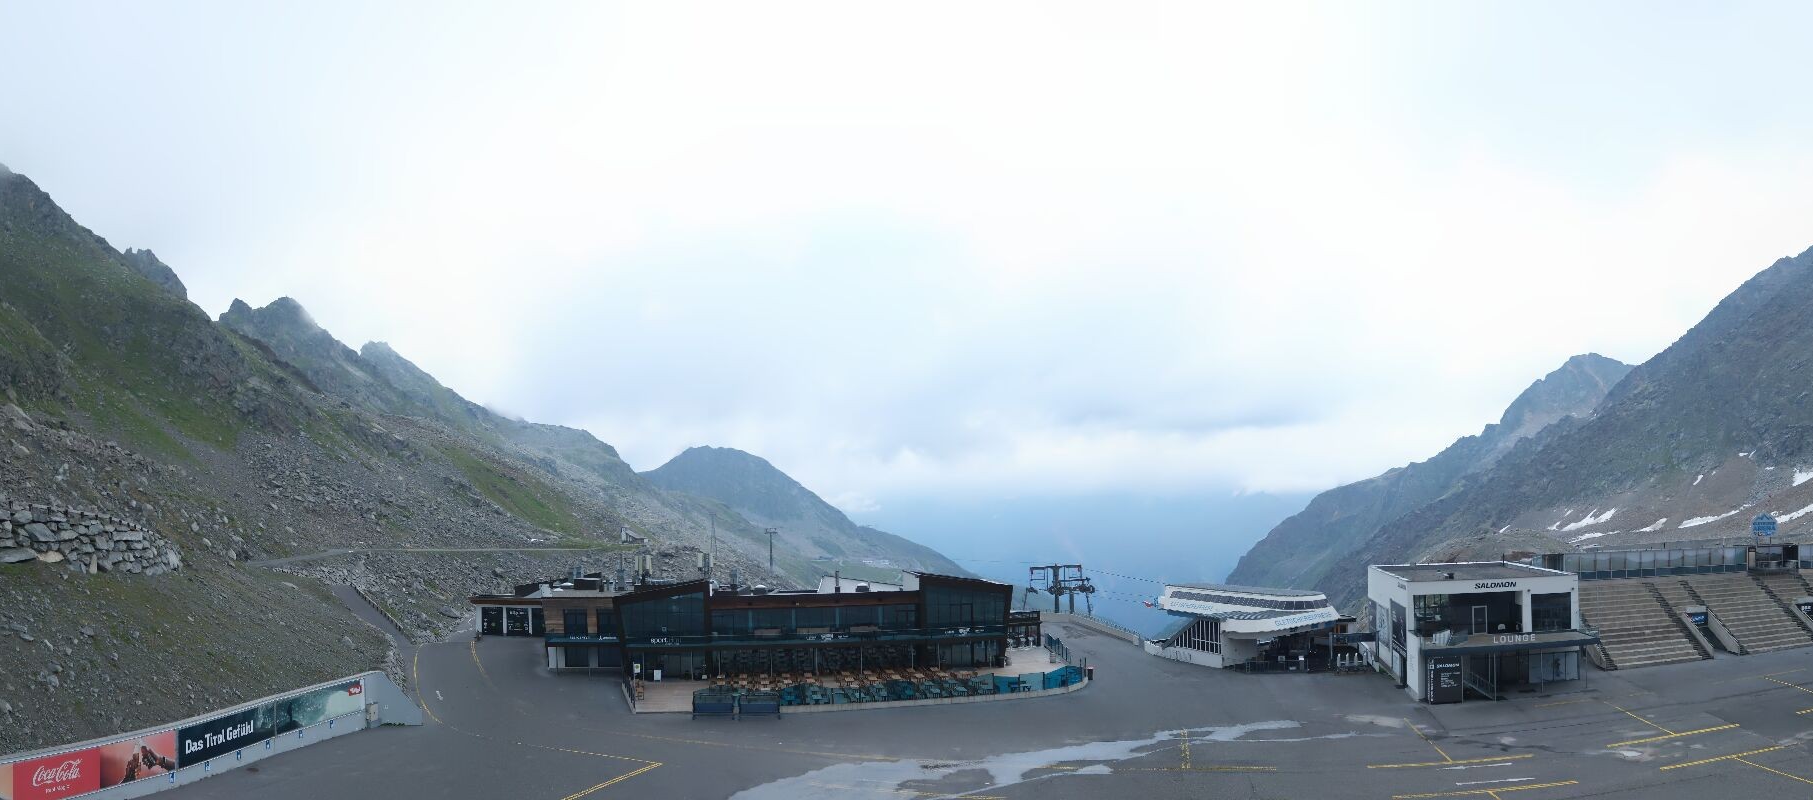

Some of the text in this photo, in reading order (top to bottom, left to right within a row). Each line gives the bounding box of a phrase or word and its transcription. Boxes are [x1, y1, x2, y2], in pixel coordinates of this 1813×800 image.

[1474, 581, 1517, 589] SALOMON
[1493, 634, 1536, 643] LOUNGE
[185, 719, 254, 755] Das Tirol Gefühl
